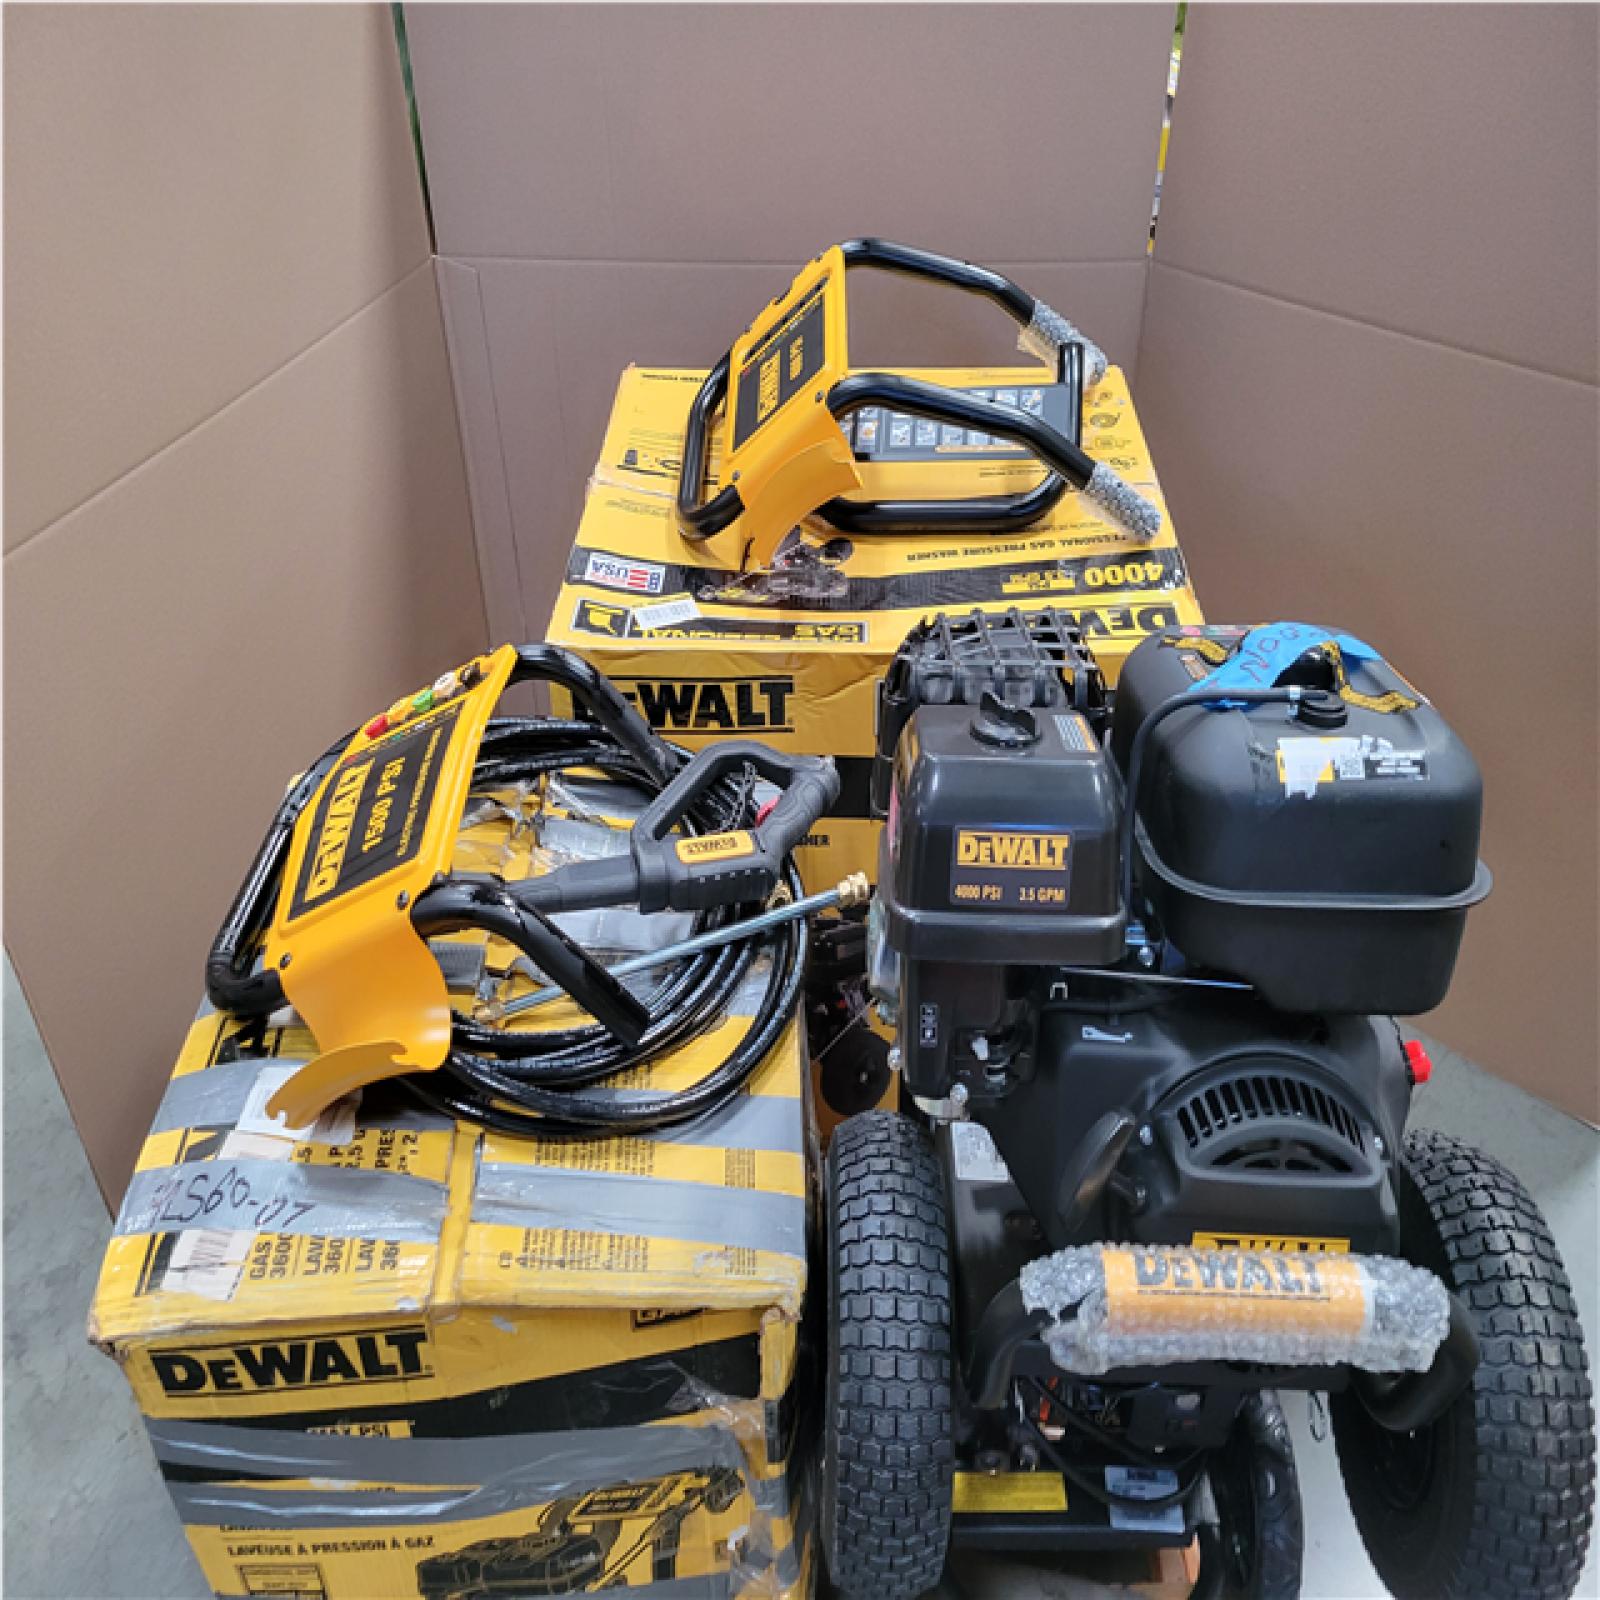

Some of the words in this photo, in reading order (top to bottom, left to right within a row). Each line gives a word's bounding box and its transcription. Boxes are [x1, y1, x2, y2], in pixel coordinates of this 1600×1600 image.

[1085, 561, 1165, 587] 4000
[305, 757, 377, 902] DEWALT
[957, 830, 1070, 870] DEWALT
[249, 1241, 272, 1280] GAS
[1133, 1250, 1325, 1295] DEWALT
[150, 1330, 429, 1394] DEWALT
[228, 1543, 292, 1557] LAVEUSE
[312, 1539, 386, 1554] PRESSION
[405, 1535, 434, 1548] GAZ
